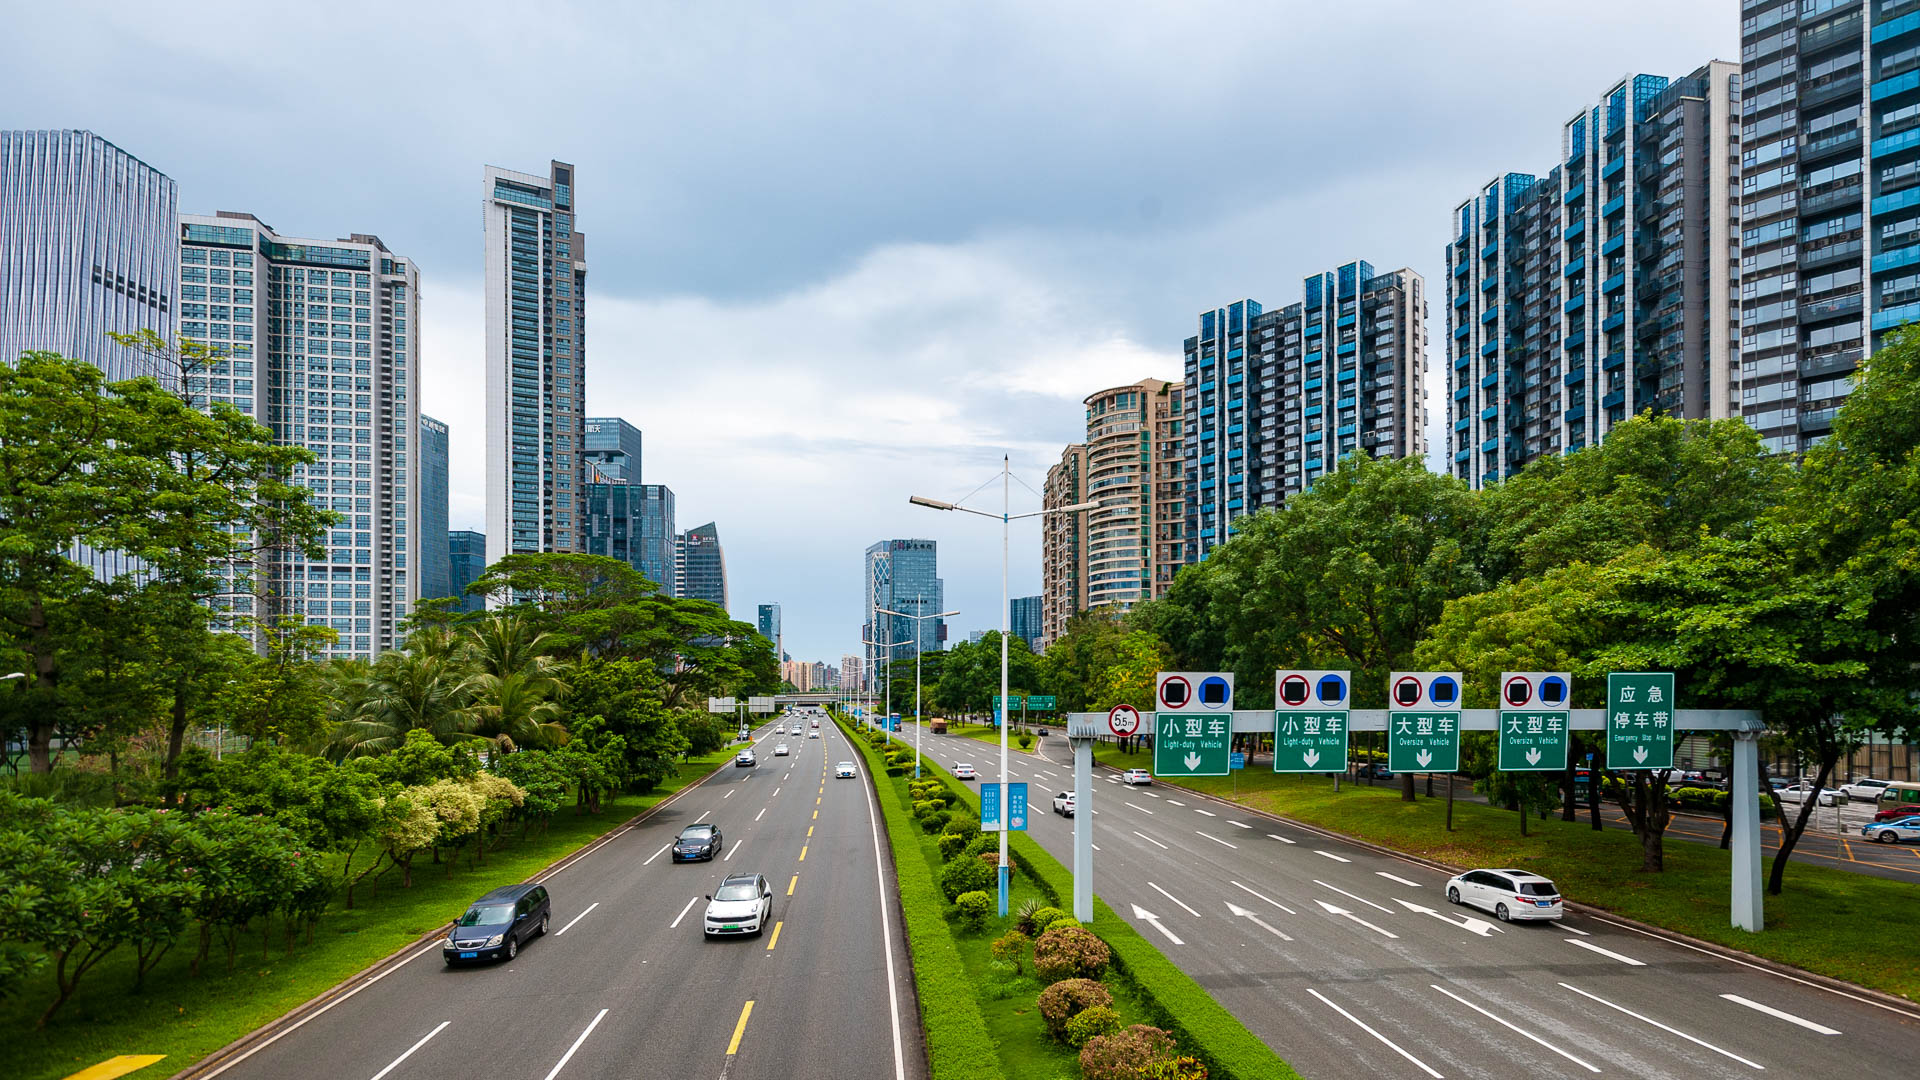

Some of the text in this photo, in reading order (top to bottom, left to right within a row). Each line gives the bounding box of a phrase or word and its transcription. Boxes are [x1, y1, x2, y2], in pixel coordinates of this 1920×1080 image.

[1620, 685, 1664, 703] 应急
[1162, 718, 1225, 738] 小型车
[1281, 716, 1343, 735] 小型车
[1395, 716, 1454, 735] 大型车
[1506, 715, 1563, 734] 大型车
[1613, 711, 1669, 729] 停车带
[1163, 739, 1223, 750] Light-duty Vehicle
[1283, 737, 1340, 748] Light-duty Vehicle
[1399, 737, 1450, 746] Oversize Vehicle
[1509, 736, 1559, 745] Oversize Vehicle
[1614, 734, 1638, 743] Emergency
